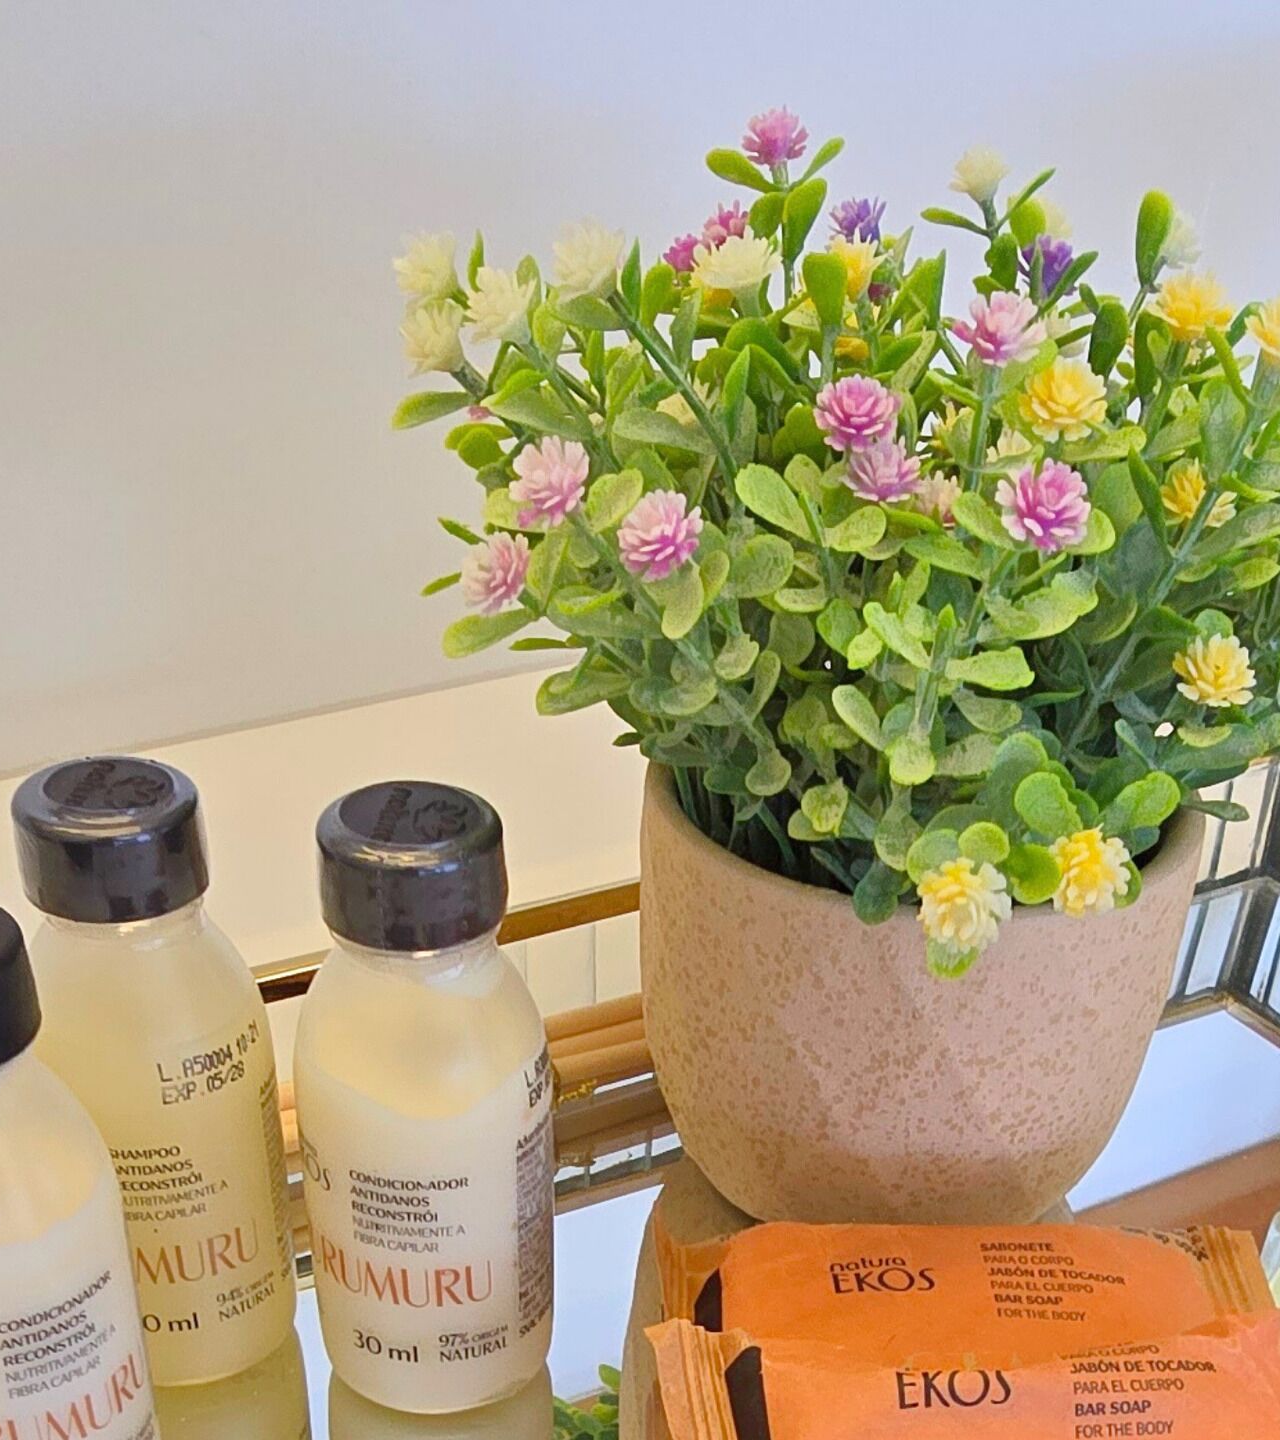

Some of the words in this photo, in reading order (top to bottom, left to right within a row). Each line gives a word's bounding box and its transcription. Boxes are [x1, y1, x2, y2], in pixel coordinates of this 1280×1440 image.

[120, 1172, 204, 1192] ECONSTRÓI
[349, 1169, 470, 1192] CONDICIONADOR
[122, 1184, 219, 1208] UTRITIVAMENTE
[350, 1185, 431, 1208] ANTIDANOS
[125, 1210, 154, 1223] BRA
[351, 1200, 439, 1224] RECONSTRÓI
[352, 1215, 455, 1238] NUTRITIVAMENTE
[457, 1225, 467, 1236] A
[135, 1218, 260, 1285] MURU
[353, 1230, 387, 1249] FIBRA
[387, 1240, 440, 1254] CAPILAR
[980, 1242, 1055, 1252] SABONETE
[320, 1234, 494, 1309] RUMURU
[829, 1256, 907, 1273] natura
[983, 1255, 1017, 1265] PARA
[1018, 1255, 1028, 1265] O
[1031, 1255, 1075, 1266] CORPO
[831, 1267, 936, 1294] EKOS
[987, 1266, 1035, 1278] JABÓN
[1038, 1269, 1059, 1279] DE
[1060, 1269, 1126, 1286] TOCADOR
[990, 1280, 1024, 1291] PARA
[1026, 1282, 1042, 1292] EL
[1043, 1282, 1094, 1294] CUERPO
[994, 1293, 1023, 1304] BAR
[1026, 1295, 1063, 1306] SOAP
[142, 1313, 161, 1333] 0
[168, 1311, 200, 1332] ml
[997, 1308, 1023, 1318] FOR
[1025, 1309, 1049, 1320] THE
[1052, 1310, 1086, 1322] BODY
[0, 1310, 88, 1351] ANTIDANOS
[438, 1332, 470, 1348] 97%
[2, 1322, 97, 1368] RECONSTRÓI
[353, 1329, 382, 1355] 30
[388, 1345, 420, 1364] ml
[439, 1336, 508, 1363] NATURAL
[8, 1380, 51, 1400] FIBRA
[50, 1354, 103, 1390] CAPILAR
[1070, 1360, 1120, 1374] JABÓN
[1124, 1360, 1144, 1373] DE
[1146, 1359, 1217, 1373] TOCADOR
[896, 1368, 1012, 1411] EKOS
[1073, 1380, 1109, 1395] PARA
[1111, 1379, 1128, 1393] EL
[1130, 1378, 1184, 1392] CUERPO
[1074, 1402, 1106, 1417] BAR
[1110, 1400, 1151, 1415] SOAP
[1075, 1423, 1104, 1439] FOR
[1105, 1422, 1134, 1437] THE
[1136, 1420, 1174, 1436] BODY
